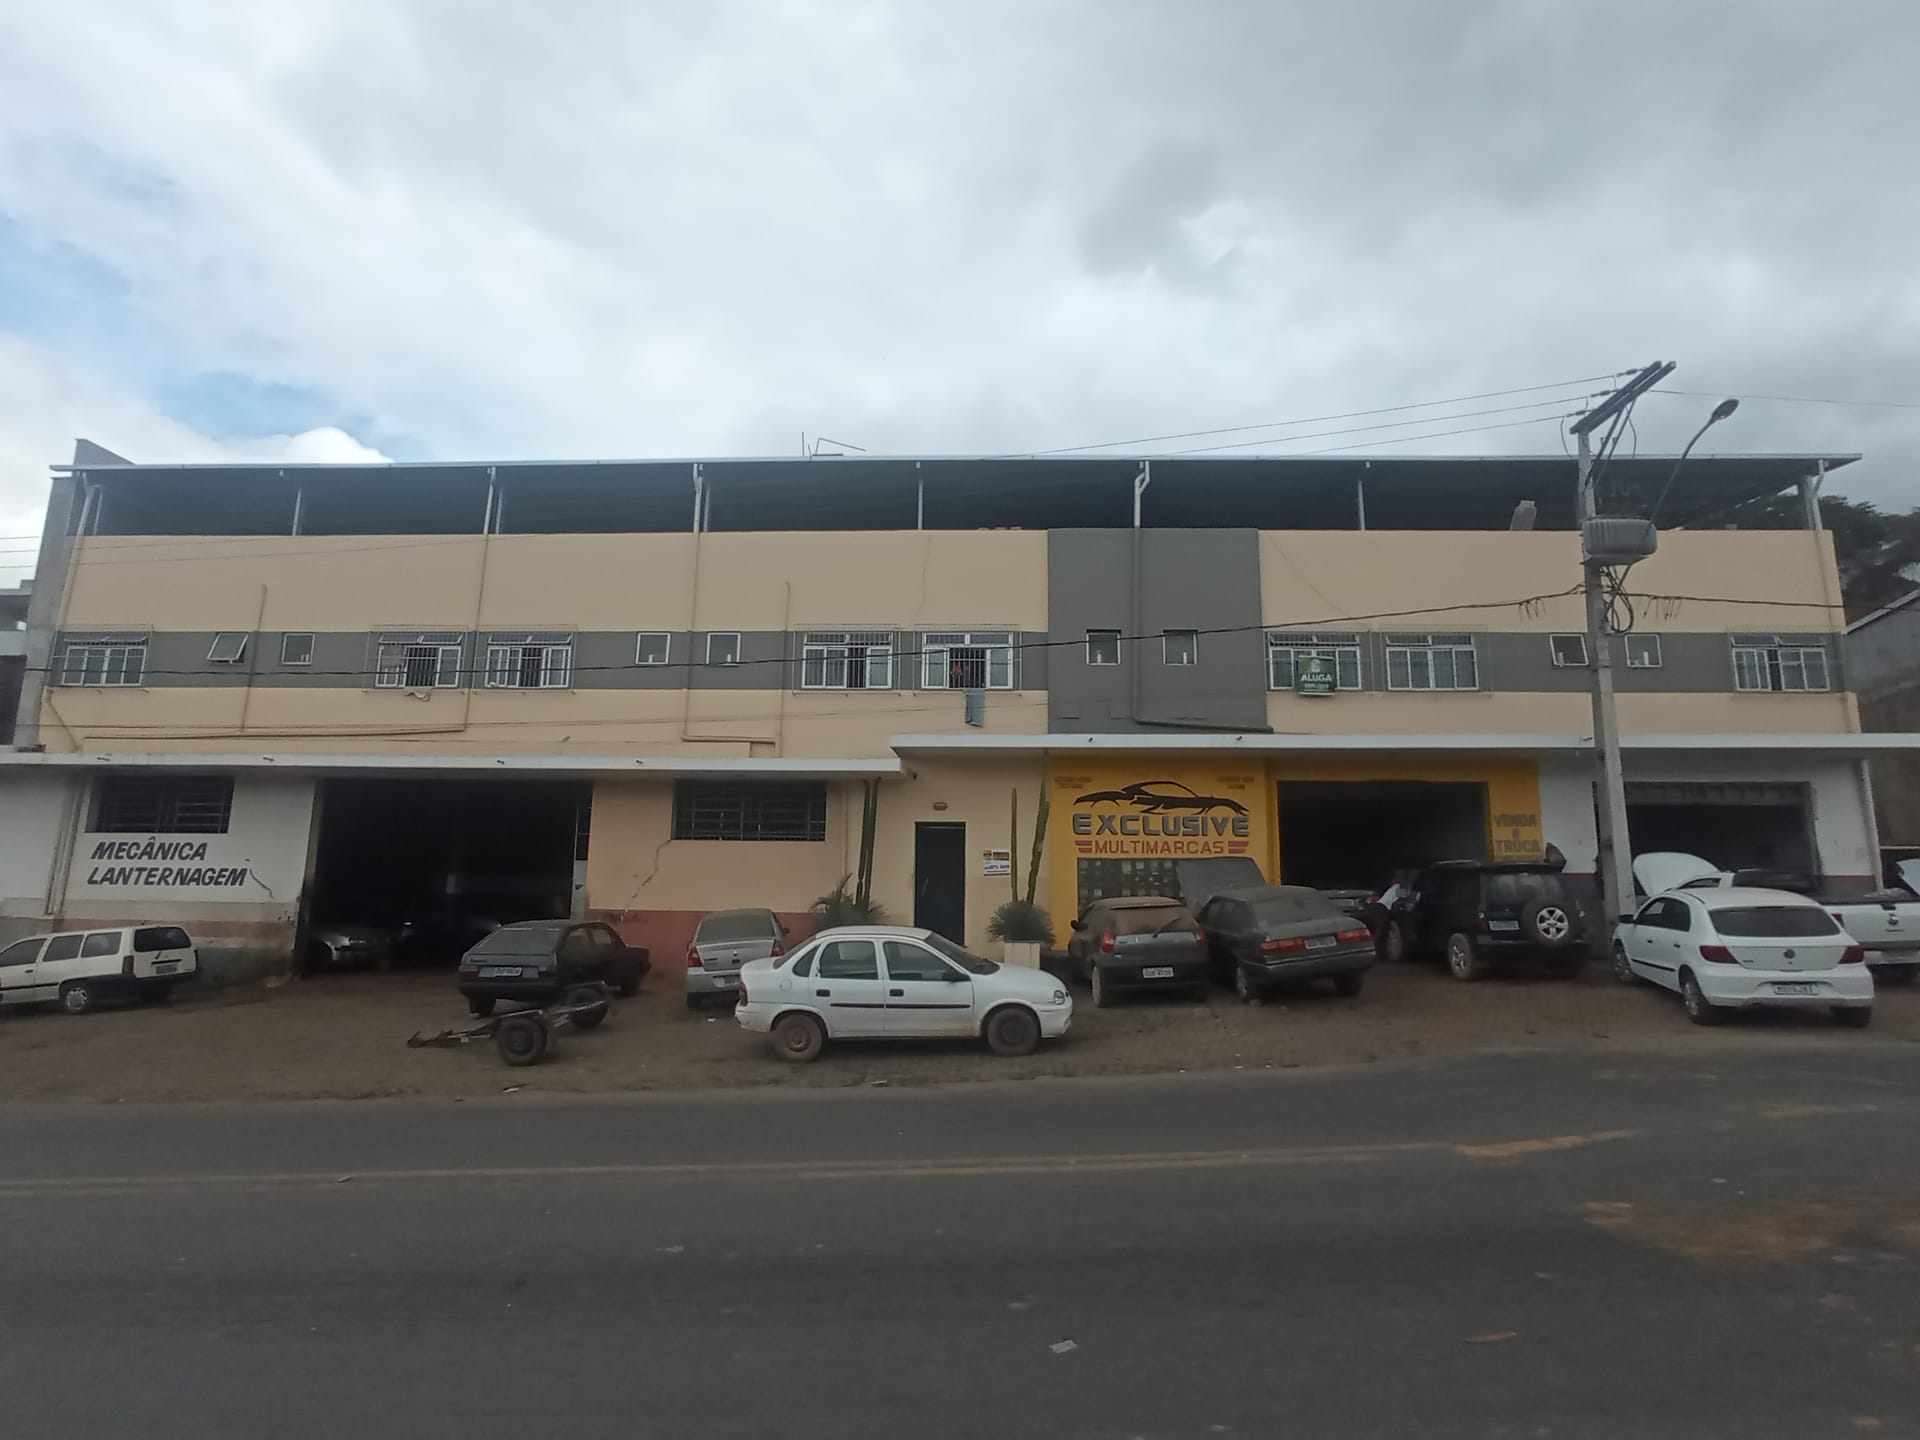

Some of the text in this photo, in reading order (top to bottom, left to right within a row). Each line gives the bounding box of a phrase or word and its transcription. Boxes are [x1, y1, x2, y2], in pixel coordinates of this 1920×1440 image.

[1300, 673, 1332, 682] ALUGA
[1072, 813, 1250, 837] EXCLUSIVE
[1495, 814, 1537, 827] VENDA
[90, 836, 208, 861] MECÂNICA
[1094, 840, 1225, 855] MULTIMARCAS
[1495, 840, 1540, 852] TROCA
[87, 866, 248, 887] LANTERNAGEM
